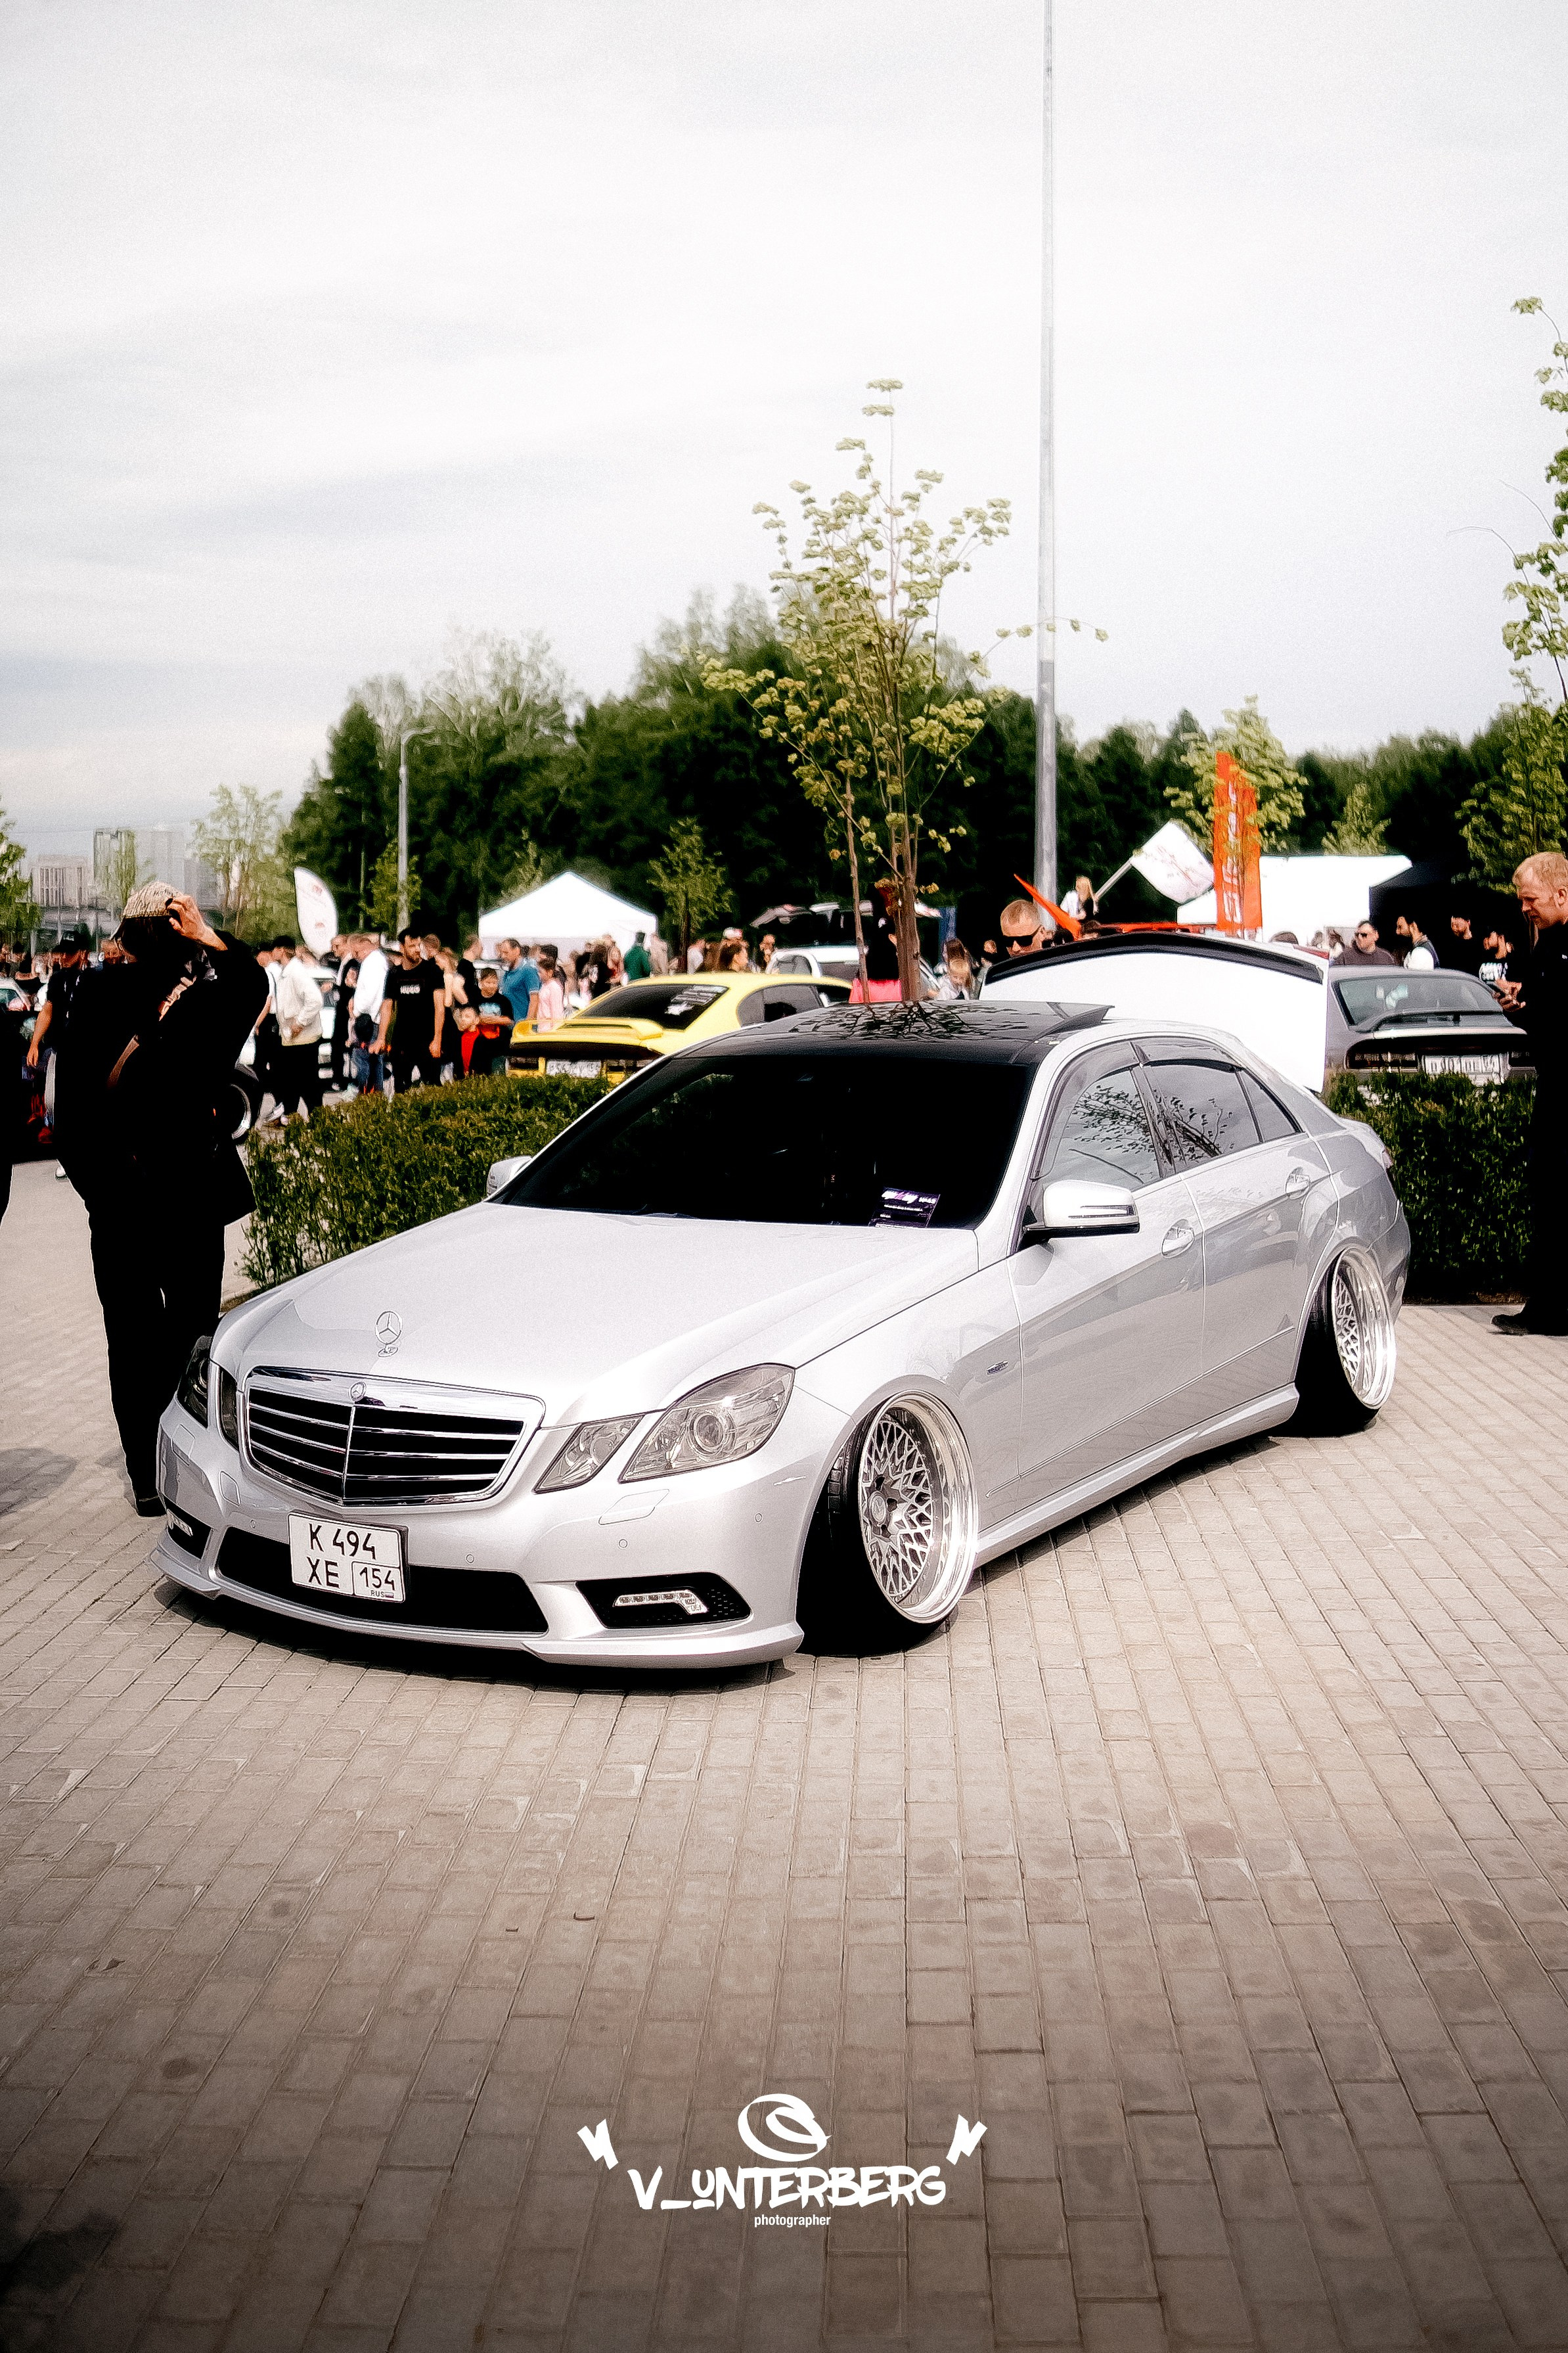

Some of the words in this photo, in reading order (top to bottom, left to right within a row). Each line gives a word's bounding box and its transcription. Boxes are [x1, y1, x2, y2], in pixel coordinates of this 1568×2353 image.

[332, 1528, 376, 1561] 494
[359, 1566, 395, 1591] 154
[370, 1589, 385, 1598] RUS
